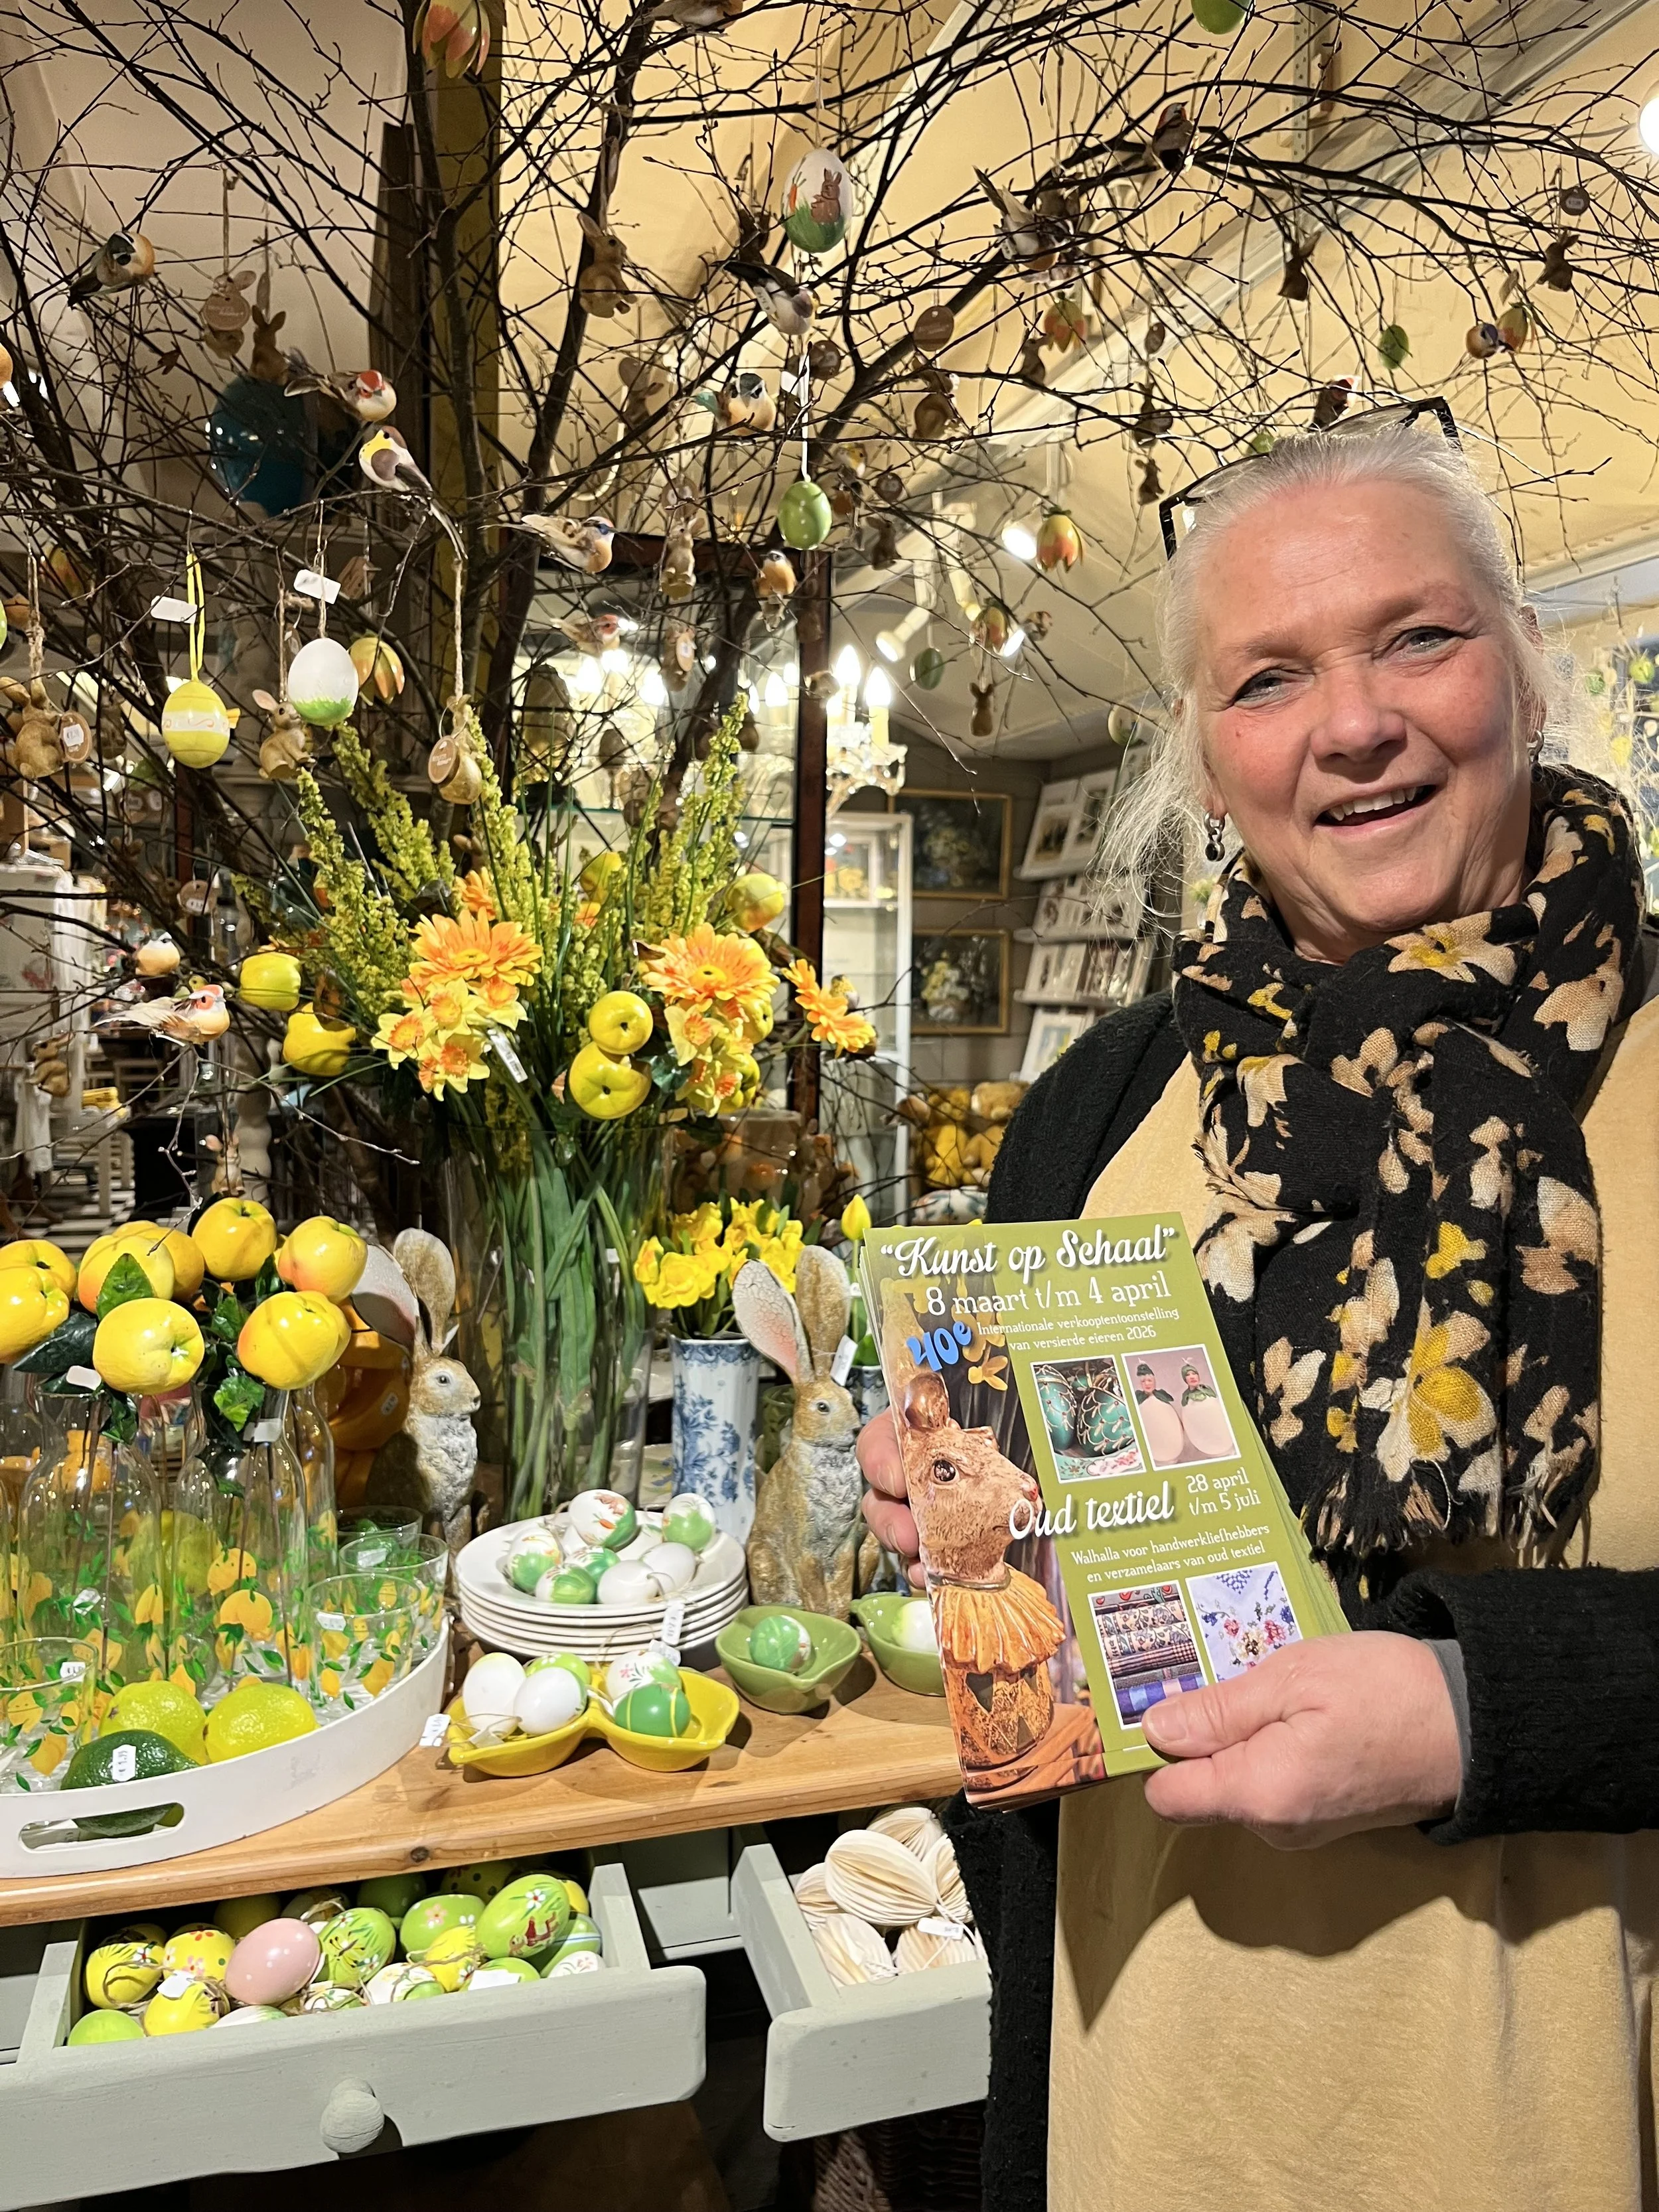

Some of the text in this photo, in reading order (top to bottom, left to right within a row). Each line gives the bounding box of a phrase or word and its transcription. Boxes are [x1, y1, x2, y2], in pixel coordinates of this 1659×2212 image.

[1008, 1245, 1046, 1285] op
[926, 1270, 1171, 1315] 8 maart t/m 4 april
[977, 1306, 1179, 1335] Internationale verkooptentoonstelling
[1009, 1325, 1157, 1351] van versierde eieren 2026
[906, 1321, 972, 1371] 40e
[1185, 1467, 1250, 1494] 28 april
[1009, 1480, 1175, 1540] Oud textiel
[1189, 1489, 1261, 1516] t/m 5 juli
[1070, 1524, 1269, 1565] Walhalla voor handwerkliefhebbers
[1087, 1540, 1266, 1583] en verzamelaars van oud textiel
